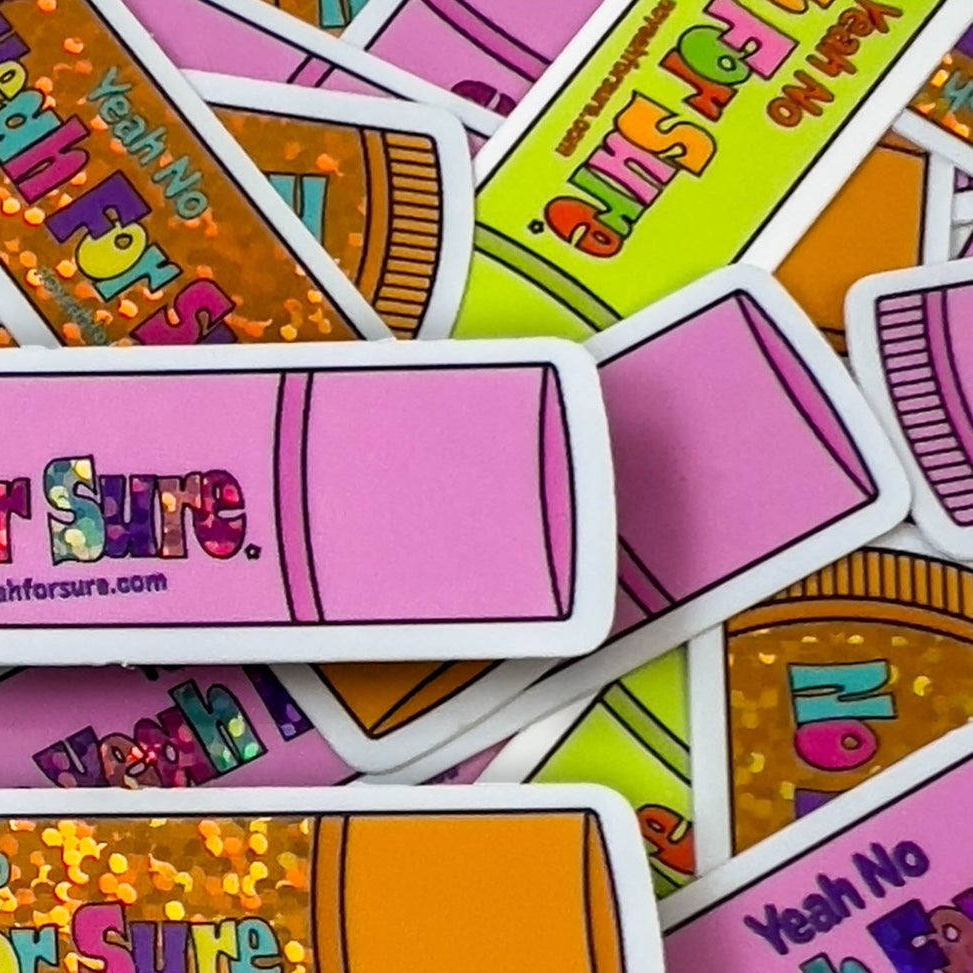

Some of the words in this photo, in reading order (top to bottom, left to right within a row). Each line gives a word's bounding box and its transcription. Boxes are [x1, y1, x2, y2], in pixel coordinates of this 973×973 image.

[87, 65, 168, 166] Yeah
[151, 156, 209, 222] No
[767, 69, 835, 128] No
[45, 169, 182, 302] For
[788, 658, 898, 773] No
[743, 872, 867, 955] Yeah
[851, 840, 931, 898] No
